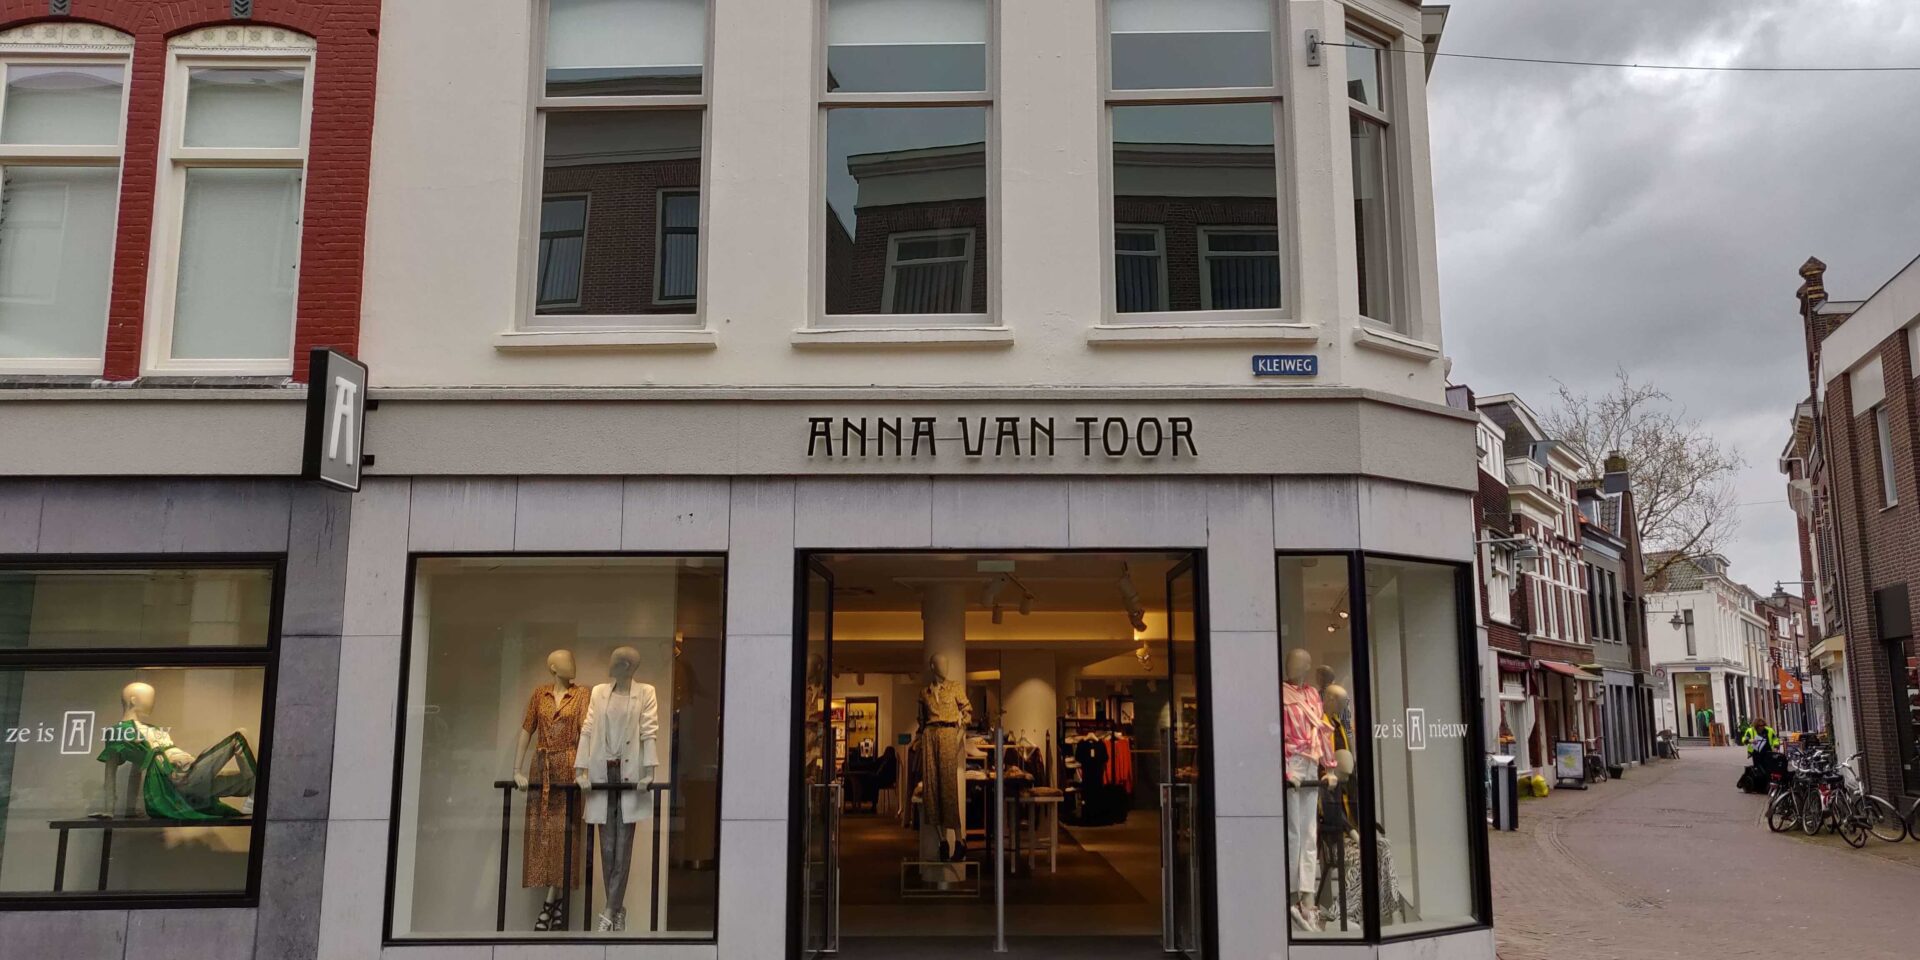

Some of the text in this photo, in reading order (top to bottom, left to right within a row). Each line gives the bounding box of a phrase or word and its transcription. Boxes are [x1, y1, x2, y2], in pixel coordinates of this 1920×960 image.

[1258, 359, 1312, 372] KLEIWEG
[329, 376, 357, 466] A
[807, 417, 1198, 456] ANNA VAN TOOR
[5, 727, 31, 743] ze
[37, 722, 55, 742] is
[1374, 723, 1389, 738] ze
[1392, 719, 1403, 738] is
[1429, 719, 1468, 738] nieuw
